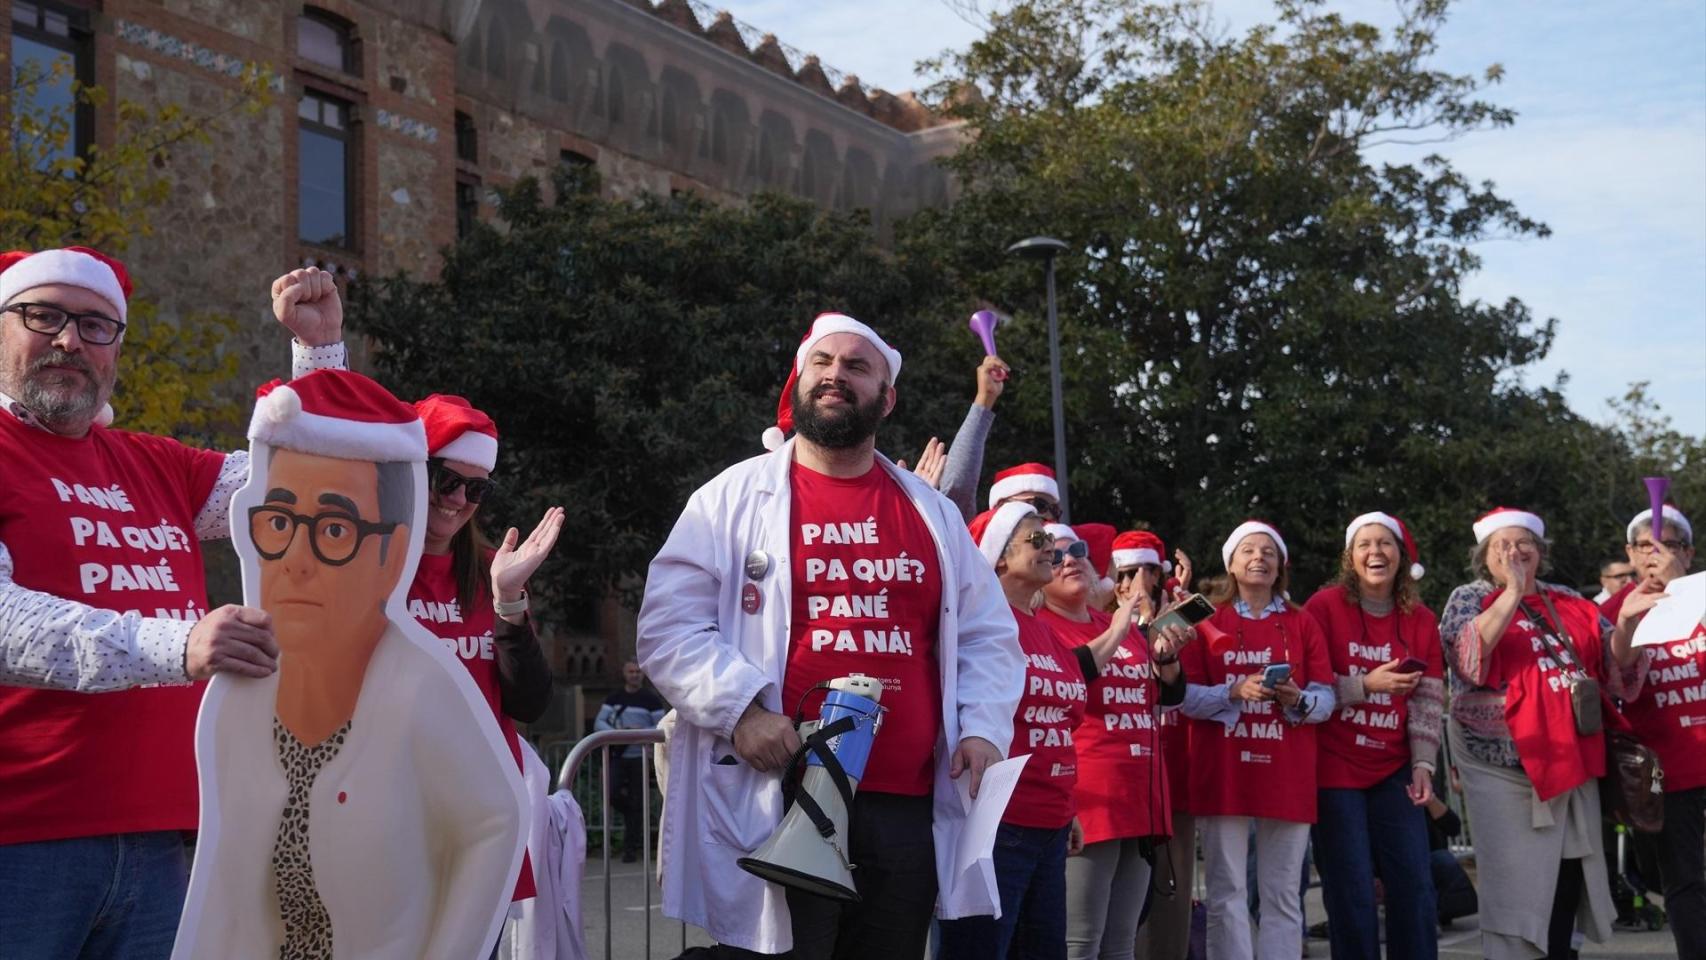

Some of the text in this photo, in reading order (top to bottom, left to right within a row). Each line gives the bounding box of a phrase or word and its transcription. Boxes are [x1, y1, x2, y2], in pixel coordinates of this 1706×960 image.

[51, 477, 135, 512] PANÉ
[70, 517, 121, 548] PA
[801, 515, 879, 545] PANÉ
[79, 557, 180, 594] PANÉ
[806, 551, 926, 584] PA QUÉ?
[409, 597, 463, 624] ANÉ
[808, 587, 889, 620] PANÉ
[440, 630, 494, 660] QUÉ
[812, 625, 912, 656] PA NÁ!
[1348, 642, 1392, 662] PANÉ
[1223, 647, 1272, 666] PANÉ
[1646, 646, 1669, 663] PA
[1649, 658, 1699, 686] PANÉ
[1030, 676, 1054, 697] PA
[1102, 683, 1146, 704] PANÉ
[1655, 689, 1682, 708] PA
[1104, 713, 1133, 731] PA
[1224, 719, 1283, 740] PA NÁ!
[1341, 706, 1399, 730] PA NÁ!
[1029, 728, 1061, 748] PA
